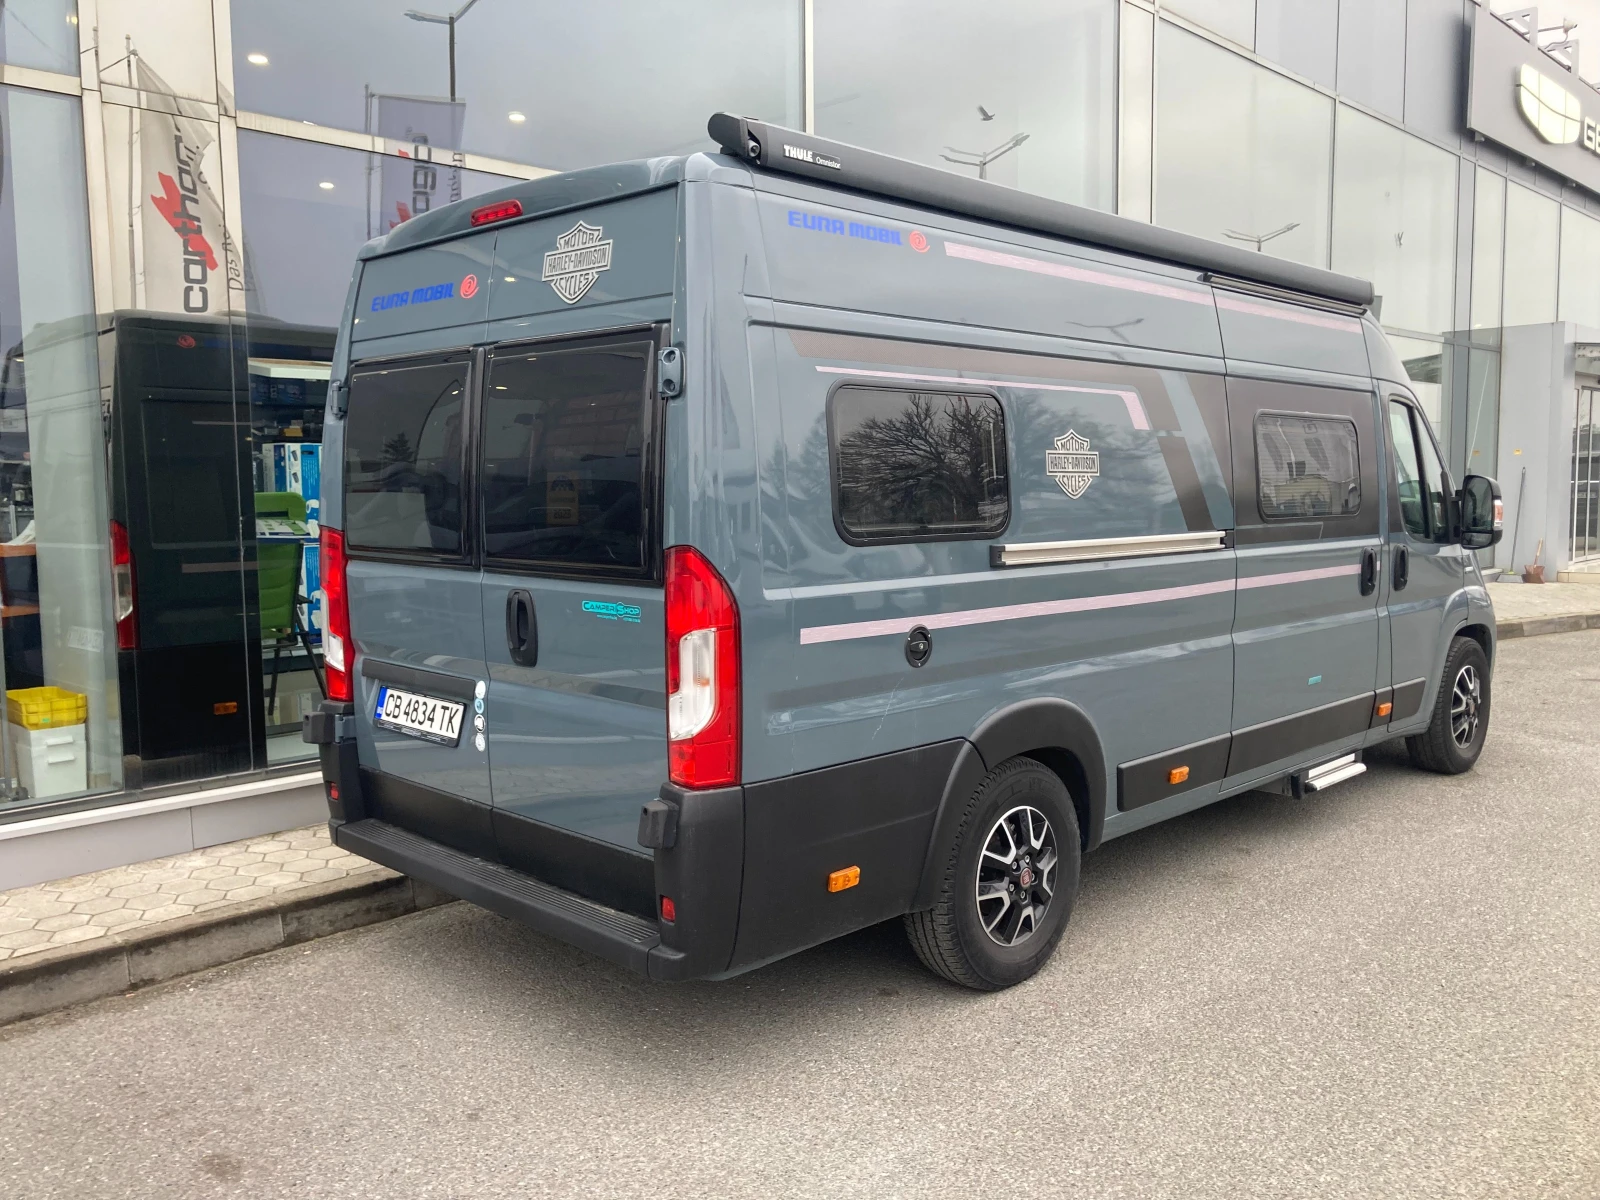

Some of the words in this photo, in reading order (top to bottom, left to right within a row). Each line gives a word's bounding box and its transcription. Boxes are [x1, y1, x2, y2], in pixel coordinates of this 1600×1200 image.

[783, 144, 813, 162] THULE
[815, 156, 841, 169] Omnistor
[563, 229, 595, 250] MOTOR
[788, 210, 845, 236] EURA
[848, 221, 904, 246] MOBIL
[547, 247, 607, 274] HARLEY-DAVIDSON
[371, 291, 410, 312] EURA
[410, 282, 454, 305] MOBIL
[558, 272, 591, 297] CYCLES
[1060, 435, 1085, 452] MOTOR
[1048, 456, 1096, 471] HARLEY-DAVIDSON
[1061, 474, 1086, 494] CYCLES
[384, 693, 402, 719] CB
[403, 697, 438, 728] 4834
[439, 704, 460, 734] TK
